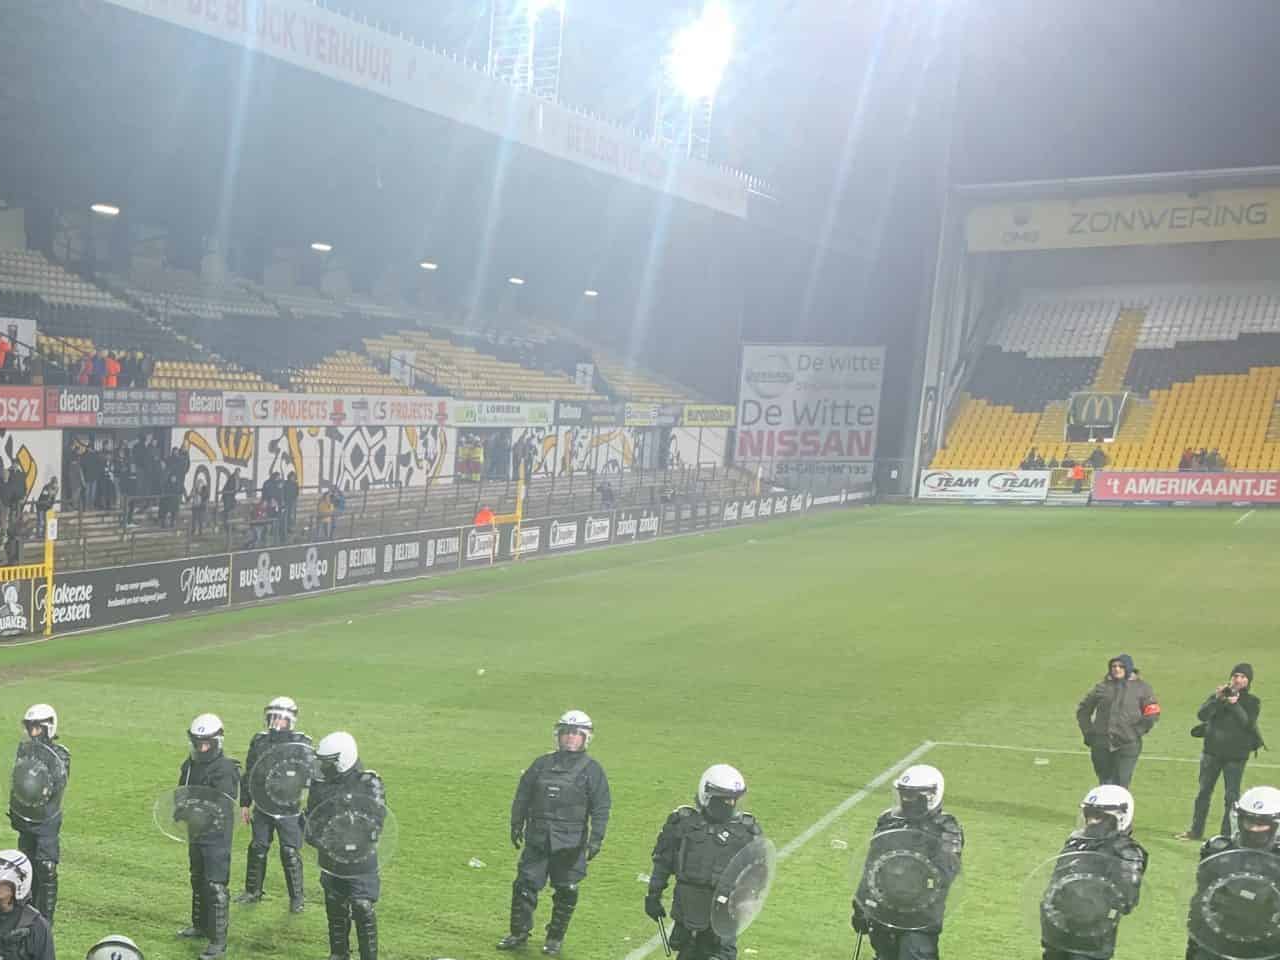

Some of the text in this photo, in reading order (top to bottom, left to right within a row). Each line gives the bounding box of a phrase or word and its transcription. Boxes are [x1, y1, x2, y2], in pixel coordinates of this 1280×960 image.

[1068, 200, 1272, 236] ZONWERING
[60, 389, 100, 412] decaro
[273, 399, 328, 421] PROJECTS
[390, 401, 434, 421] PROJECTS
[741, 400, 782, 426] De
[792, 397, 875, 426] Witte
[738, 430, 873, 457] NISSAN
[936, 477, 980, 488] TEAM
[1002, 477, 1046, 489] TEAM
[1124, 478, 1278, 497] AMERIKAANTJE
